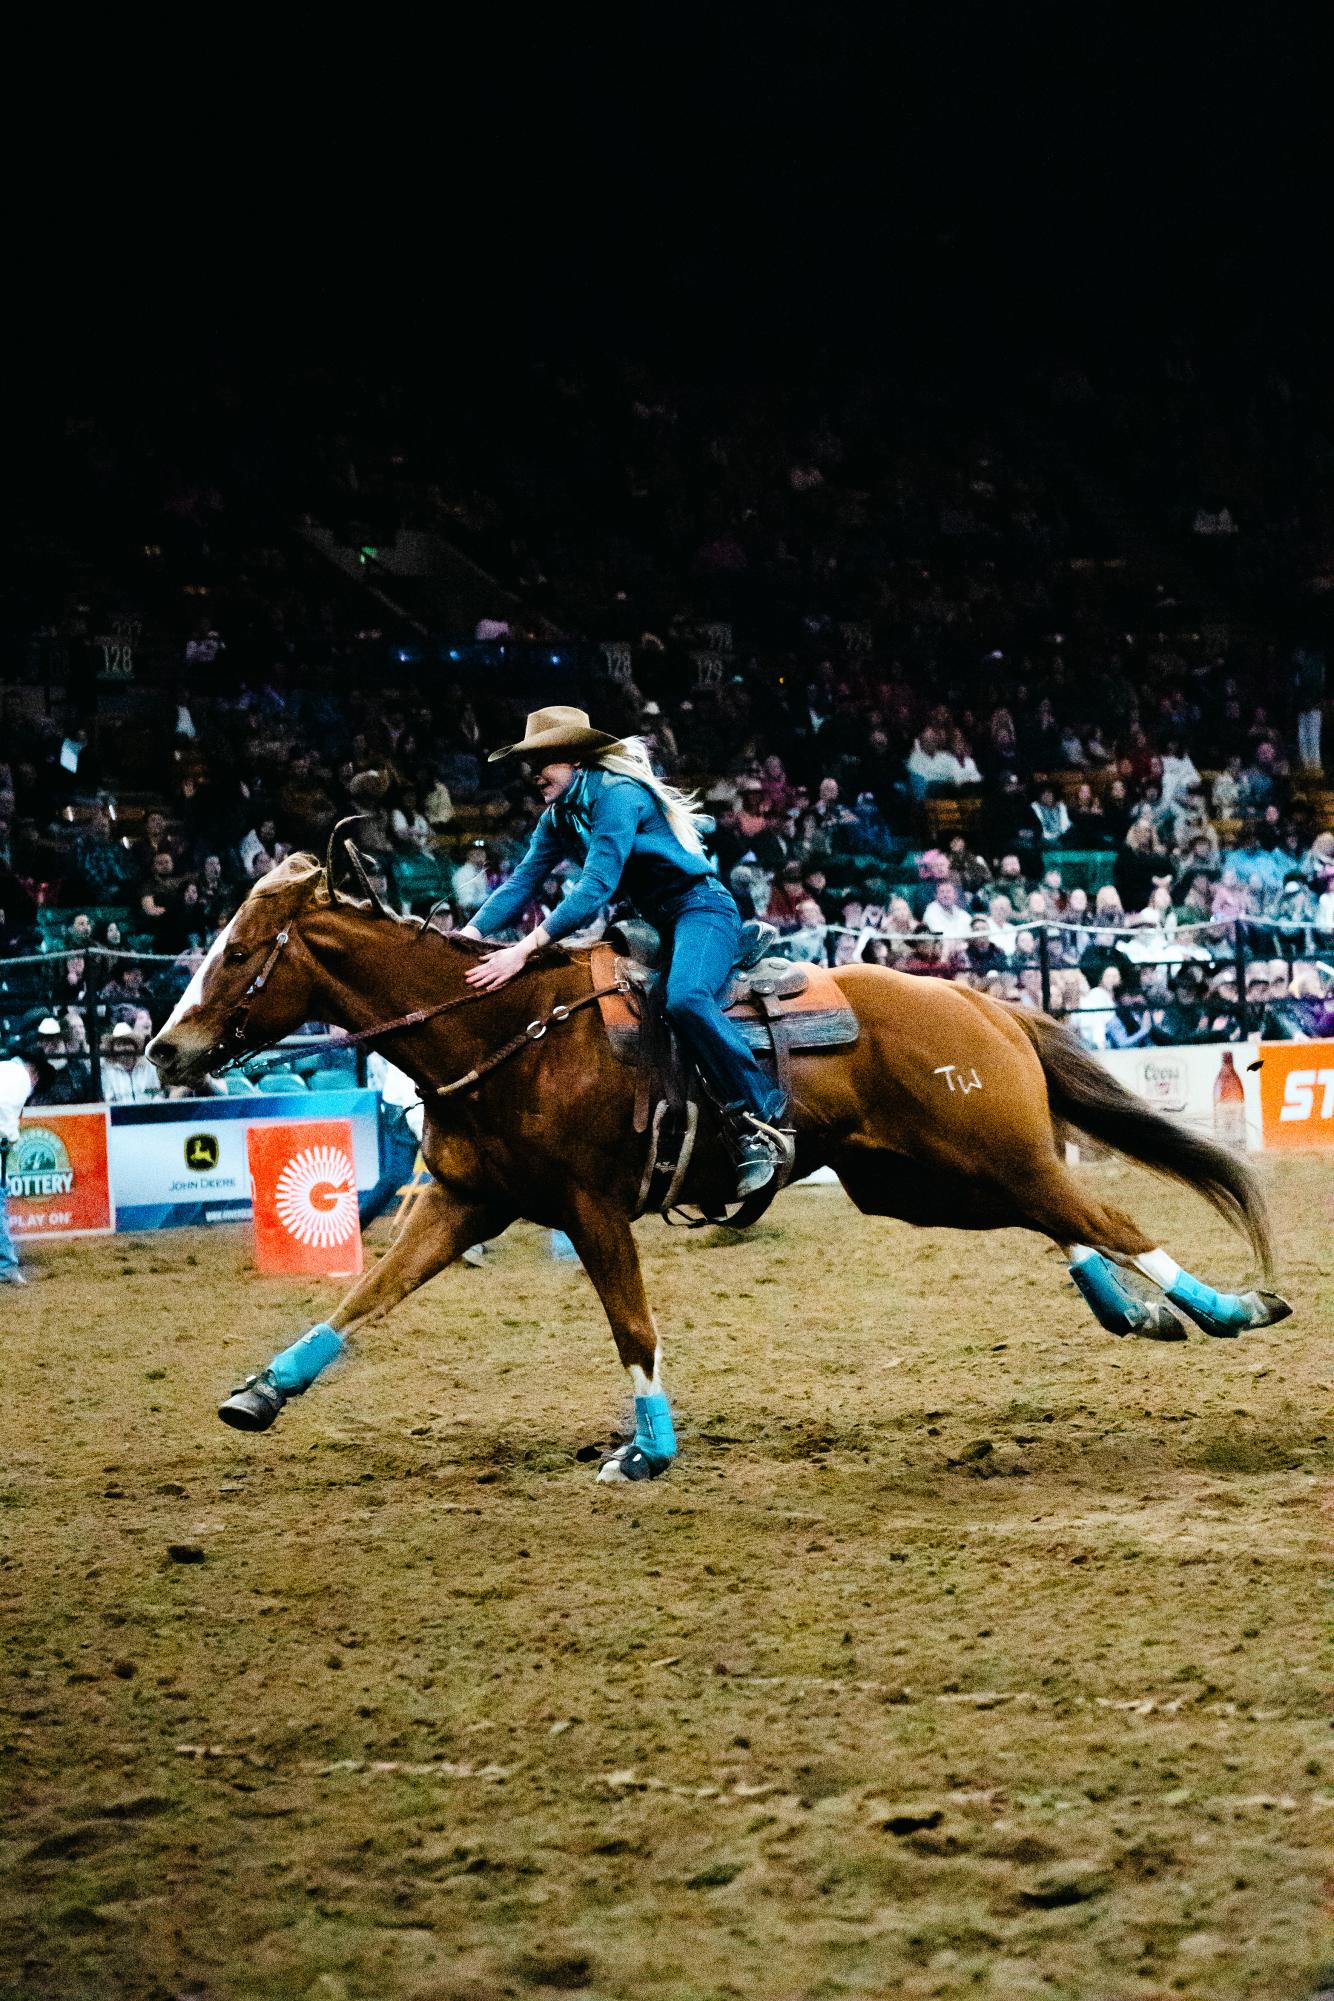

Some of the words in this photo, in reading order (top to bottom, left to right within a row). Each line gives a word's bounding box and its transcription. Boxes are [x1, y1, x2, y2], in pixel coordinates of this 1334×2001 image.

[104, 645, 132, 673] 128
[933, 1064, 983, 1095] TW
[48, 1211, 73, 1224] ON
